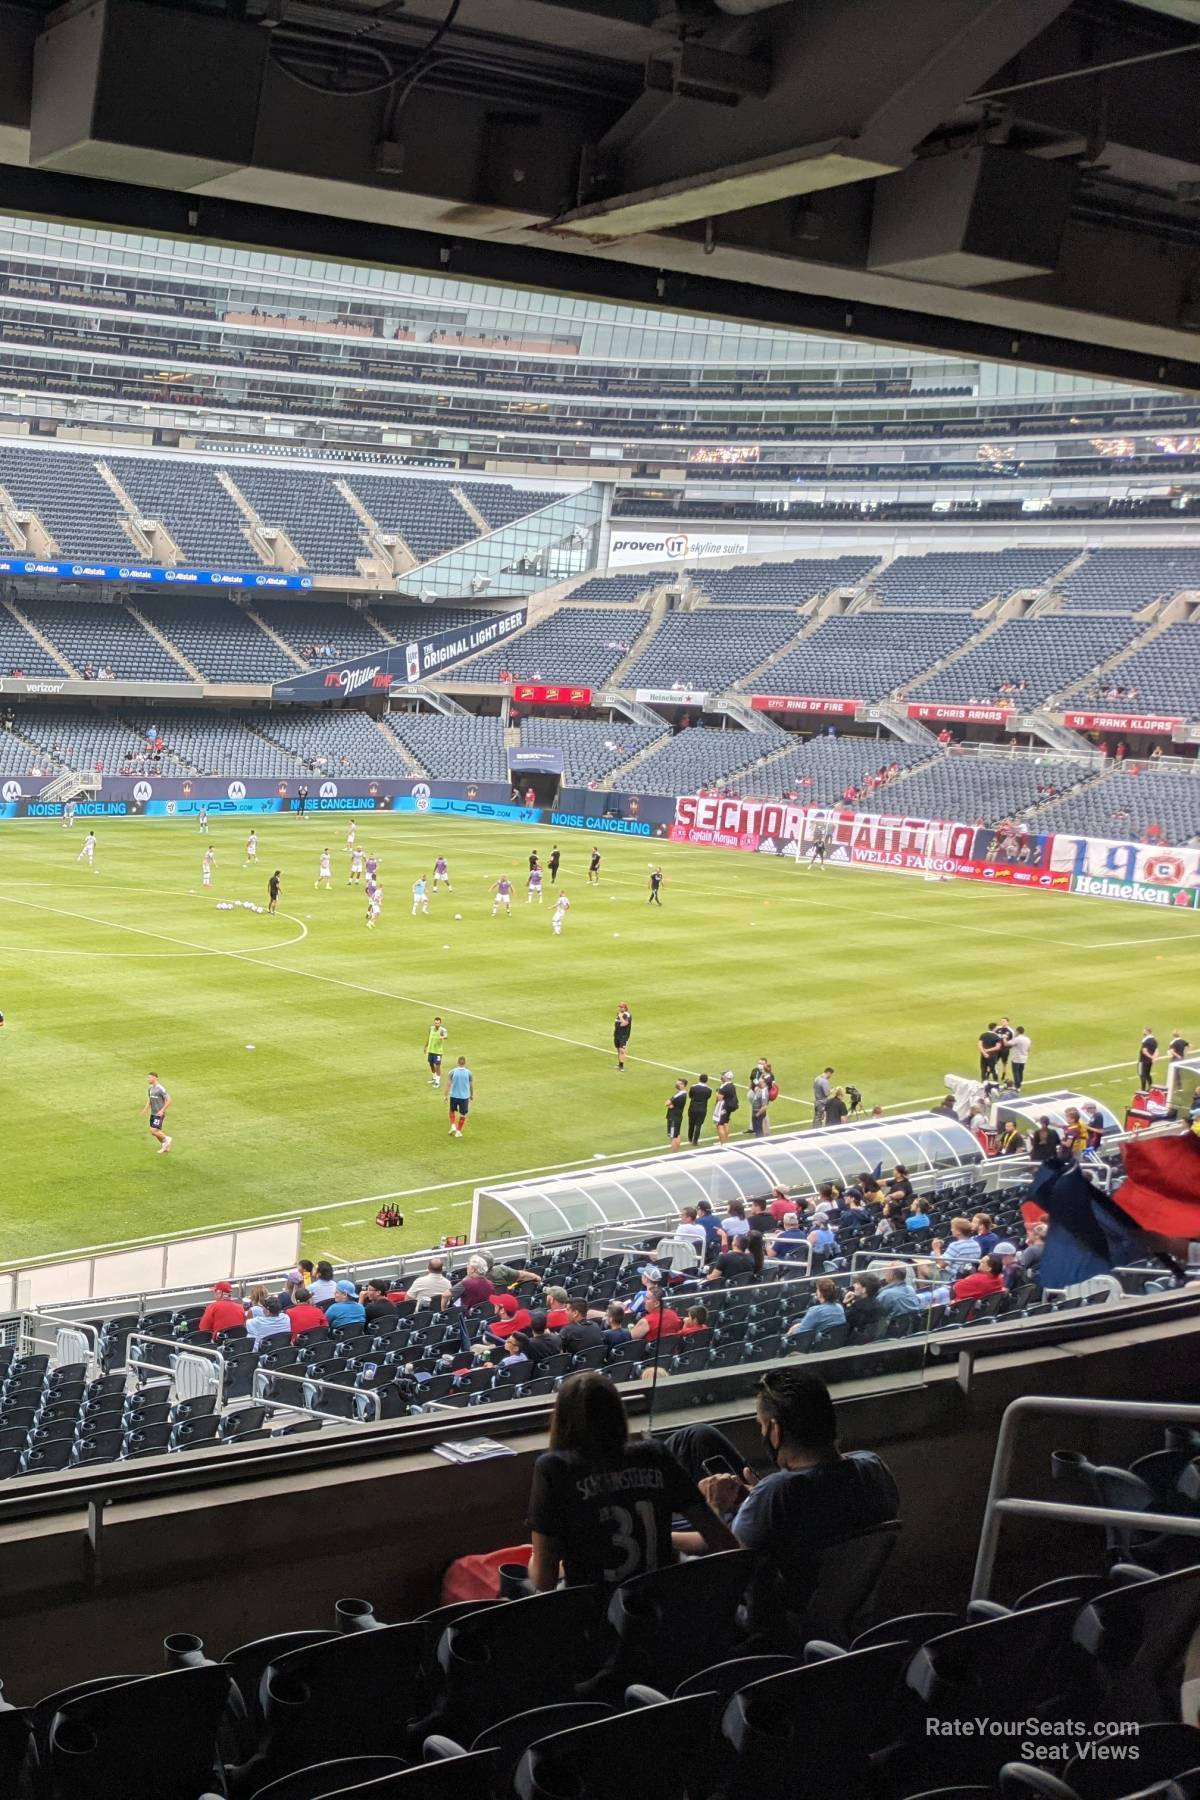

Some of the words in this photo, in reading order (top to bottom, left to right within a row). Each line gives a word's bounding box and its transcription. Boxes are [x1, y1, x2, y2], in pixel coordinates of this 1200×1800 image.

[613, 540, 664, 552] proven
[671, 541, 684, 550] IT
[690, 542, 722, 556] skyline
[722, 544, 745, 554] suite
[35, 564, 58, 573] Allstate
[82, 567, 106, 576] Allstate
[130, 570, 152, 578] Allstate
[175, 573, 198, 581] Allstate
[220, 575, 243, 584] Allstate
[266, 577, 288, 586] Allstate
[424, 642, 469, 669] ORIGINAL
[470, 624, 498, 648] LIGHT
[498, 612, 523, 634] BEER
[340, 666, 380, 696] Miller
[372, 673, 394, 688] TIME
[26, 683, 60, 694] verizon
[650, 694, 683, 702] Heineken
[786, 701, 806, 710] RING
[810, 702, 822, 710] OF
[824, 702, 844, 712] FIRE
[919, 708, 929, 716] 14
[936, 709, 965, 718] CHRIS
[968, 710, 1002, 720] ARMAS
[1074, 716, 1085, 726] 41
[1092, 718, 1127, 728] FRANK
[1130, 719, 1172, 730] KLOPAS
[28, 804, 61, 816] NOISE
[73, 803, 126, 815] ANCELING
[290, 800, 318, 810] NISE
[320, 798, 375, 810] CANCELING
[432, 802, 511, 817] JLAB.COM
[551, 813, 584, 827] NOISE
[586, 816, 650, 836] CANCELING
[677, 797, 801, 840] SECTOR
[831, 812, 975, 860] LATINO
[688, 828, 712, 842] Captain
[712, 831, 738, 846] Morgan
[856, 848, 902, 866] WELLS
[904, 852, 956, 873] FARGO
[1075, 876, 1170, 904] Heineken
[599, 1500, 658, 1582] 31
